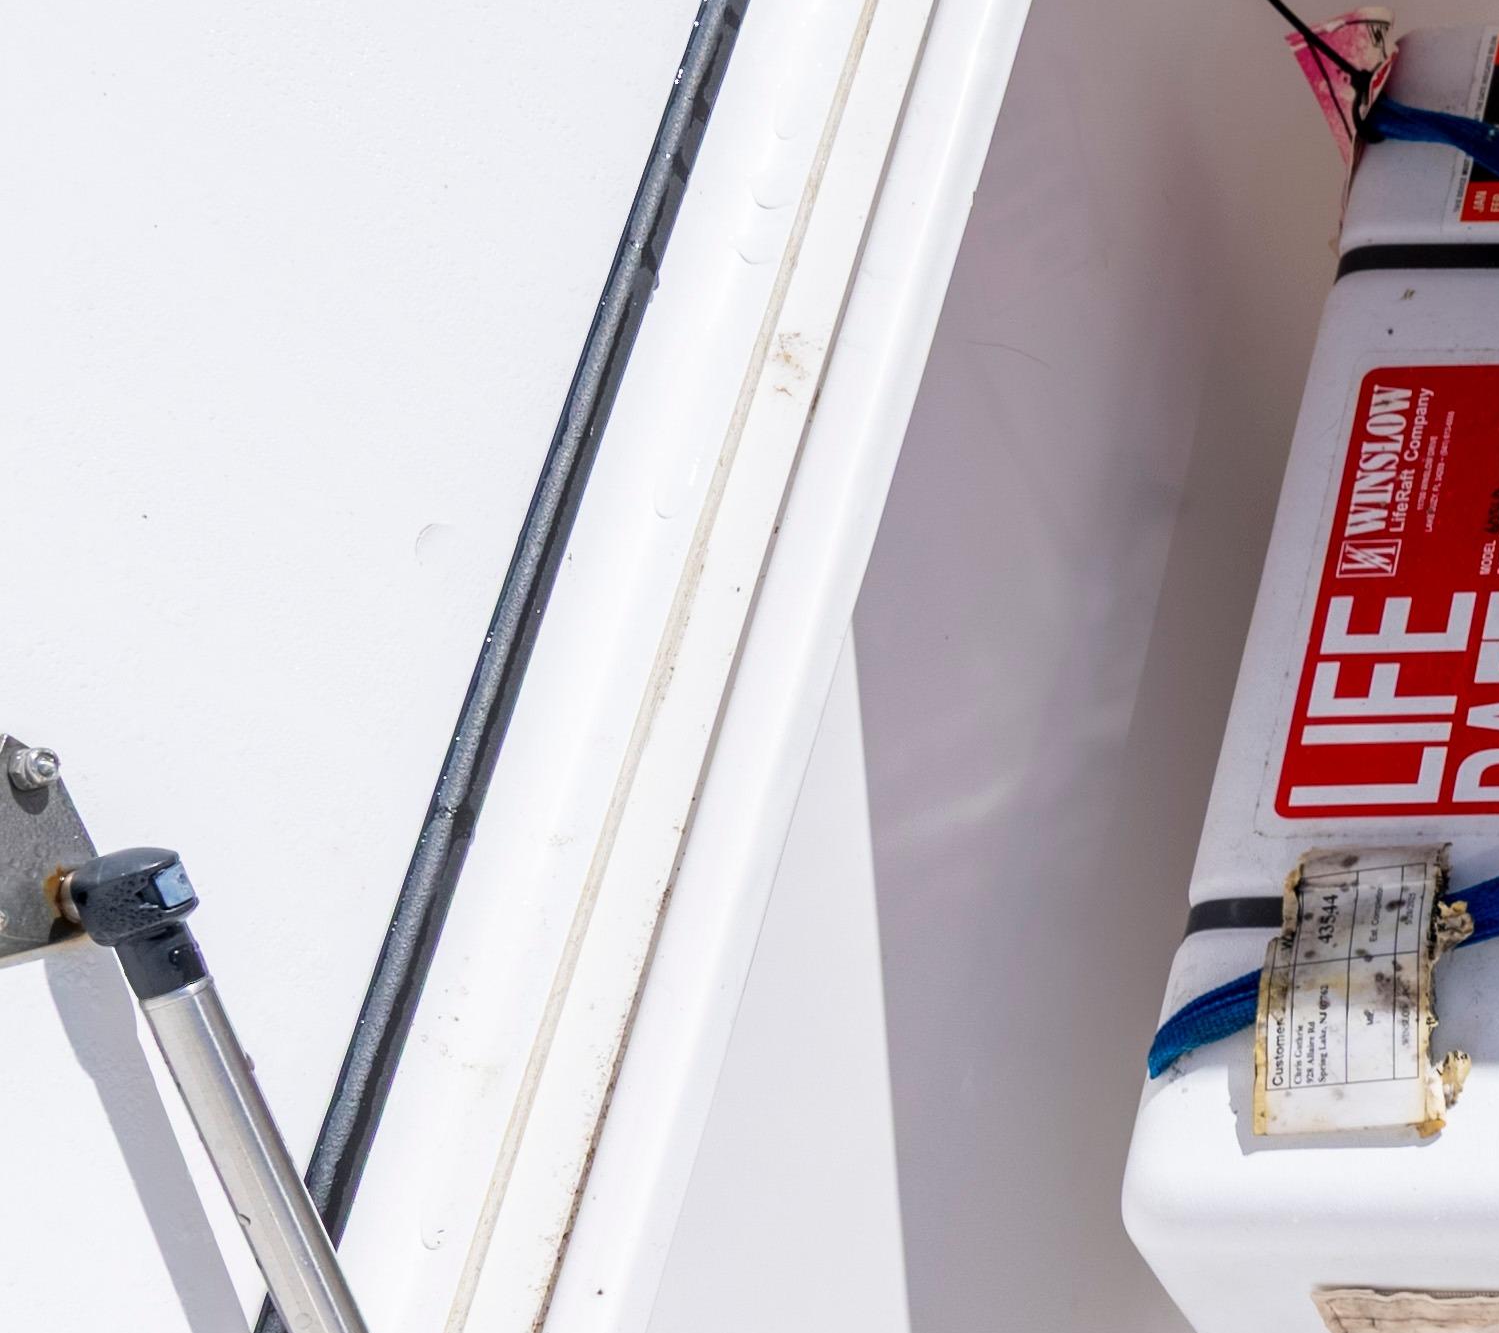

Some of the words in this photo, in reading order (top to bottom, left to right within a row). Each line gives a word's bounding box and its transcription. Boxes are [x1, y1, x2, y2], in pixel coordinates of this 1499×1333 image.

[1472, 190, 1488, 212] JAN
[1344, 384, 1413, 536] WINSLOW
[1388, 468, 1415, 532] LifeRaft
[1403, 387, 1435, 461] Company
[1479, 539, 1496, 574] MODEL
[1287, 591, 1477, 806] LIFE
[1316, 893, 1338, 944] 43544
[1307, 1020, 1316, 1033] Rd
